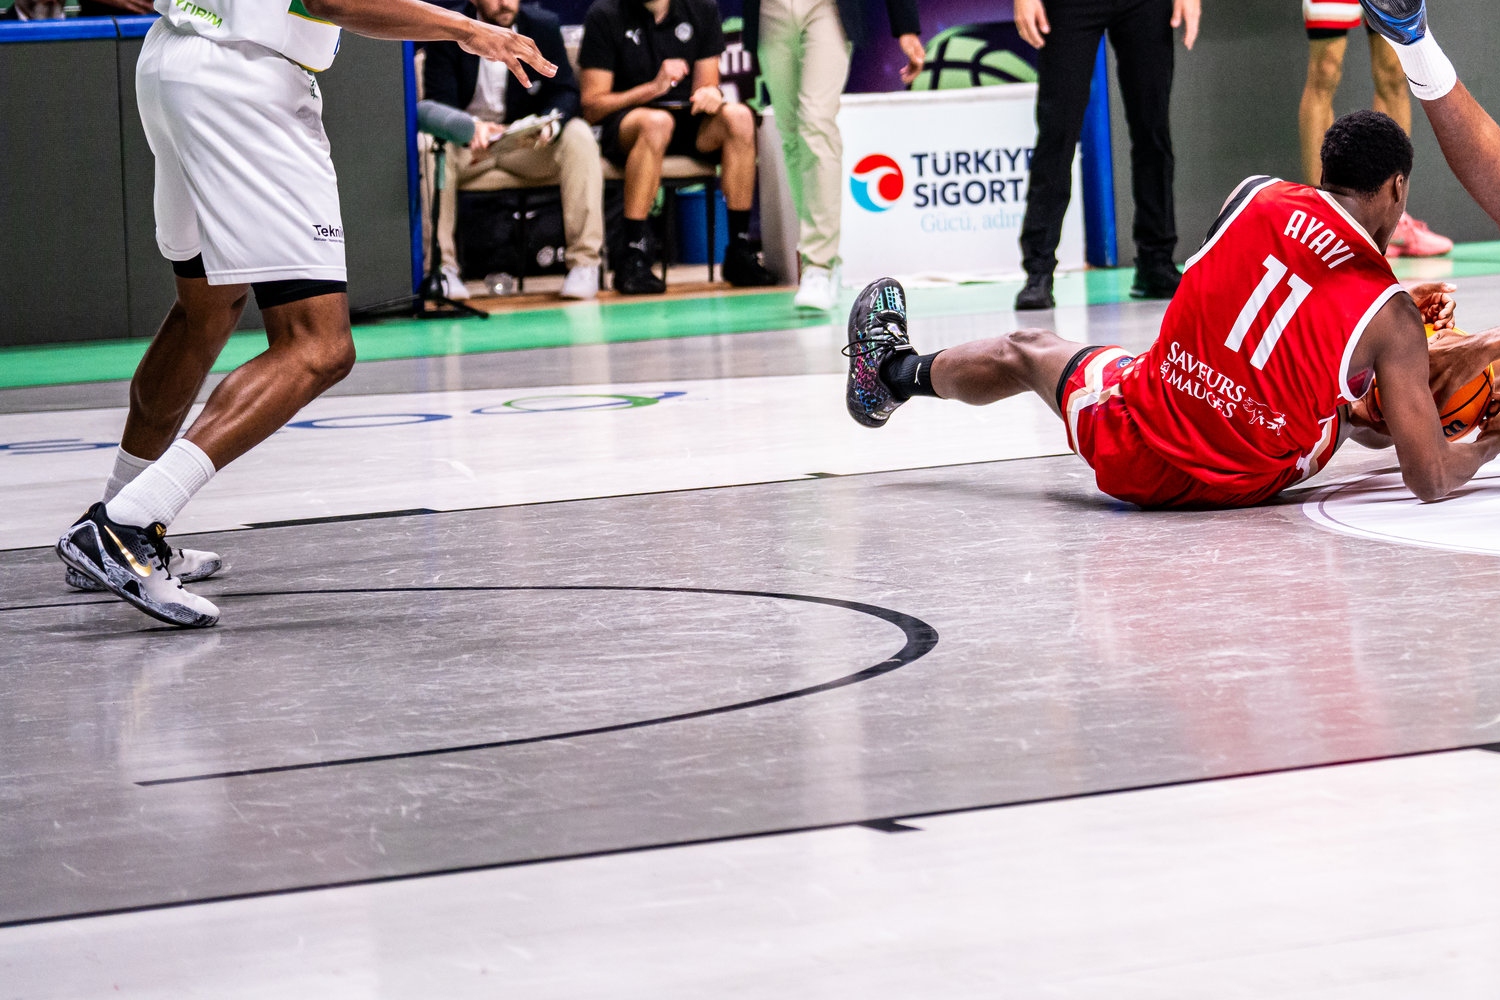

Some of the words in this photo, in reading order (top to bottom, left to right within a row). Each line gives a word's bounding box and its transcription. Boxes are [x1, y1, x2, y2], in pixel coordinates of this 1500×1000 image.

[312, 224, 343, 237] Tekn
[1283, 209, 1355, 269] AYAYI
[1224, 253, 1313, 371] 11
[1166, 341, 1247, 402] SAVEURS
[1166, 369, 1237, 418] MAUGES
